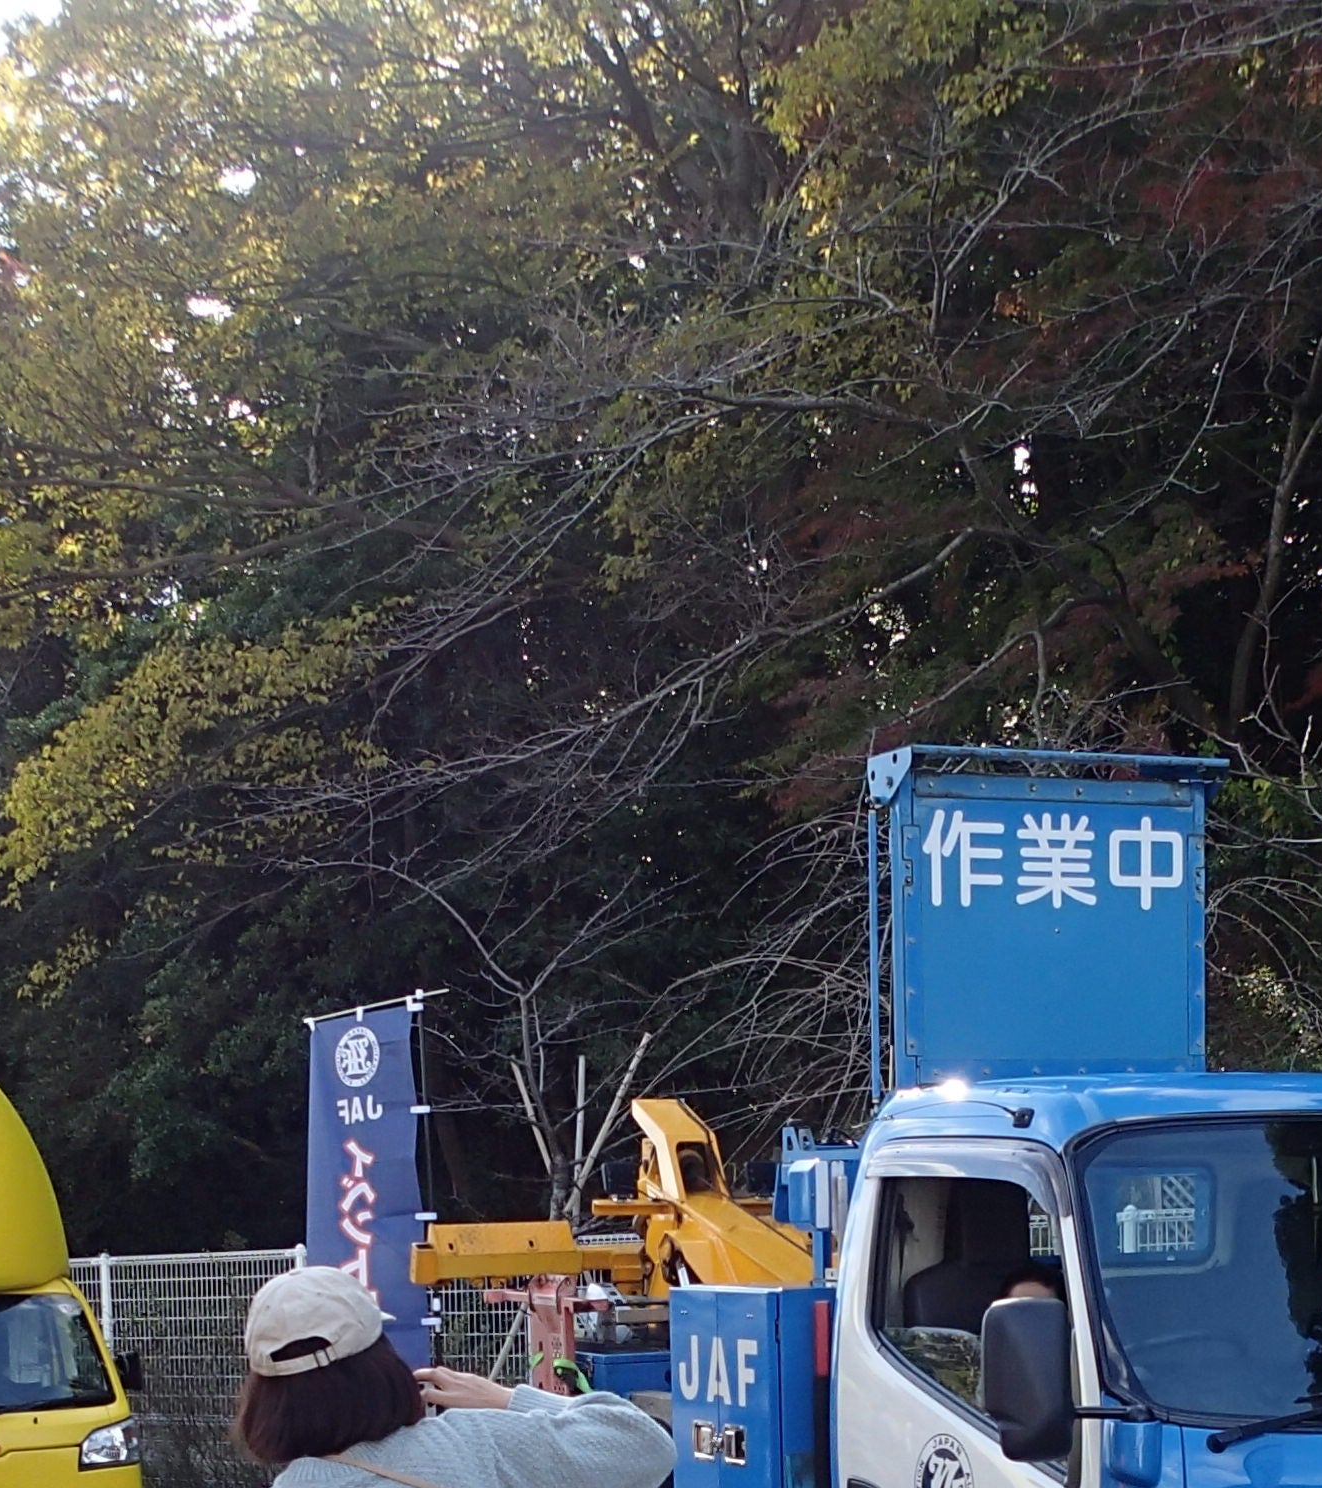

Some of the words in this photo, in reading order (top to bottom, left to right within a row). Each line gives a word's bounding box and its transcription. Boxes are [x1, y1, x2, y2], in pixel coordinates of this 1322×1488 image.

[922, 809, 1184, 911] 作業中
[678, 1334, 758, 1407] JAF
